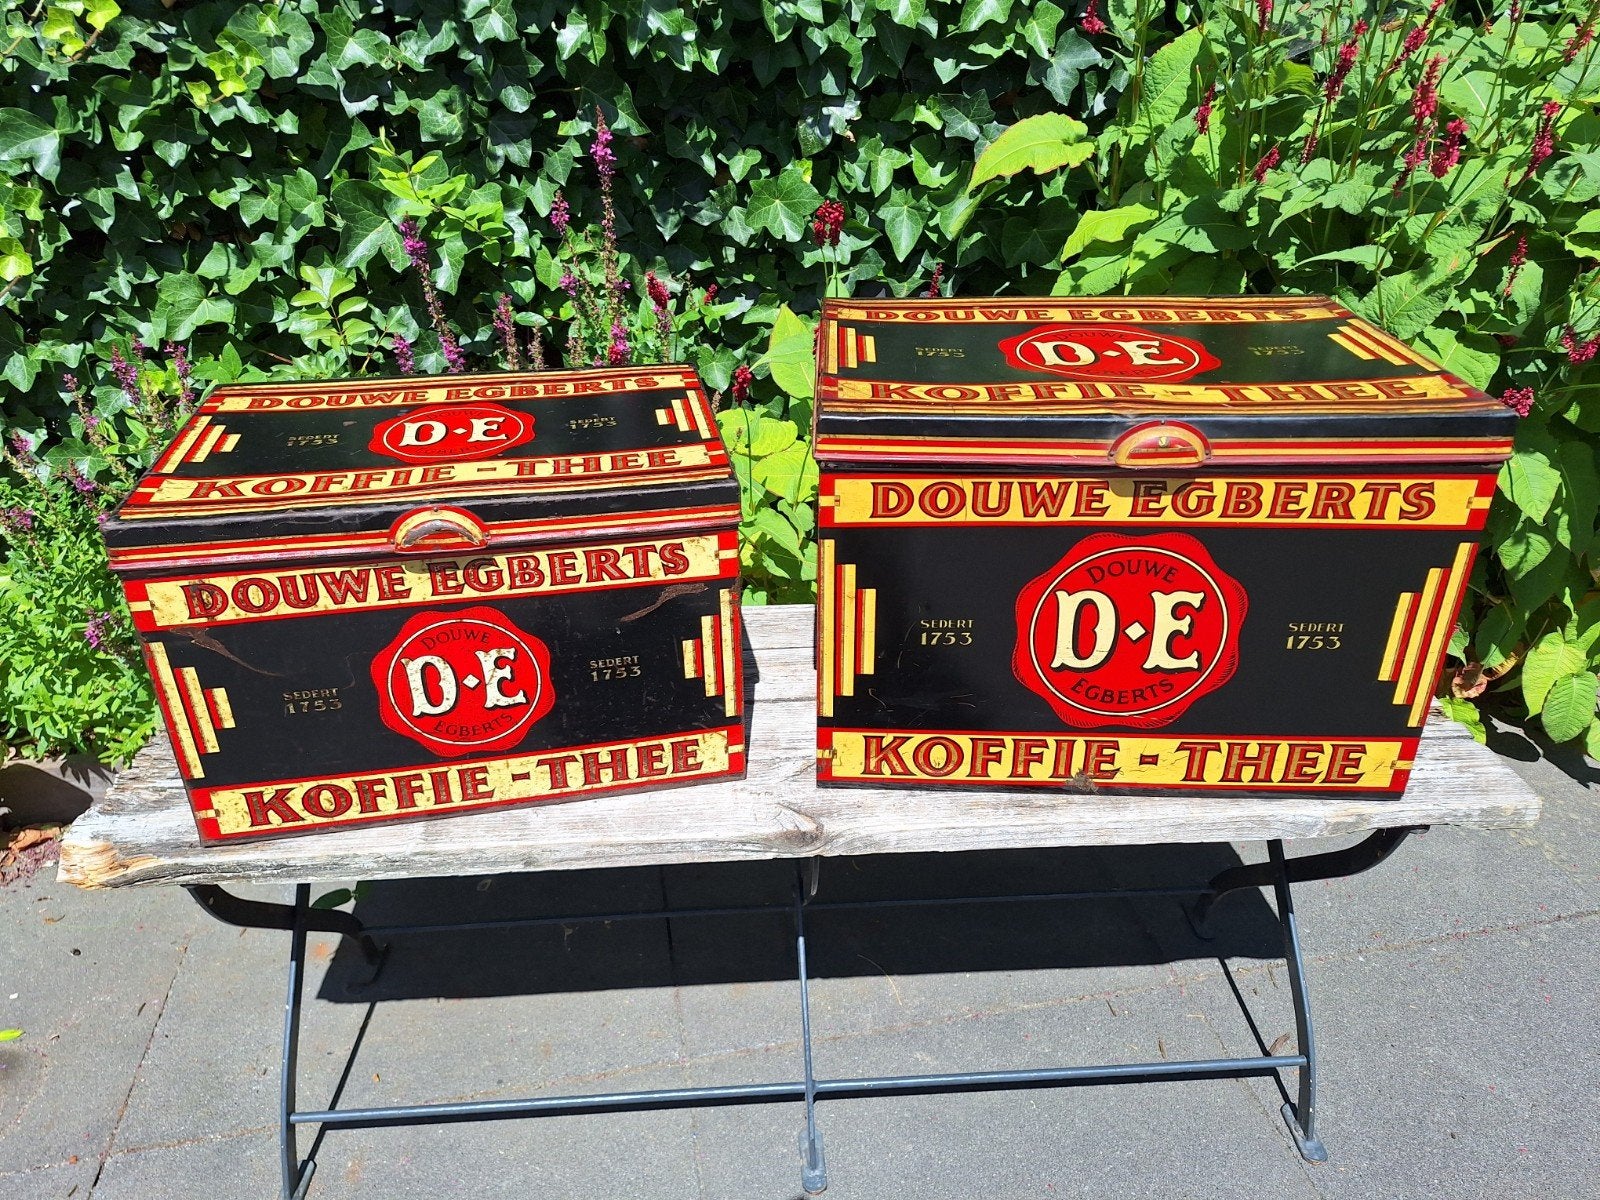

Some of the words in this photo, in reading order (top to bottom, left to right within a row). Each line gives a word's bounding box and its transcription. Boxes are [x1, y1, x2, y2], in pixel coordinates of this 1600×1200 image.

[865, 309, 1055, 321] DOUWE
[1070, 308, 1308, 322] EGBERTS
[246, 390, 429, 410] DOUWE
[445, 377, 660, 401] EGBERTS
[870, 383, 1156, 401] KOFFIE
[1204, 381, 1430, 401] THEE
[186, 465, 456, 499] KOFFIE
[504, 449, 683, 477] THEE
[869, 481, 1111, 519] DOUWE
[1128, 480, 1436, 521] EGBERTS
[180, 565, 413, 620] DOUWE
[426, 542, 690, 596] EGBERTS
[1086, 559, 1179, 584] DOUWE
[920, 619, 975, 629] SEDERT
[1288, 622, 1345, 633] SEDERT
[420, 628, 492, 650] DOUWE
[920, 631, 974, 646] 1753
[1285, 635, 1342, 650] 1753
[589, 655, 640, 670] SEDERT
[590, 666, 642, 682] 1753
[282, 687, 339, 701] SEDERT
[1071, 677, 1175, 705] EGBERTS
[283, 699, 342, 717] 1753
[433, 713, 514, 737] EGBERTS
[860, 735, 1122, 781] KOFFIE
[1174, 741, 1368, 784] THEE
[241, 765, 496, 828] KOFFIE
[536, 739, 706, 790] THEE
